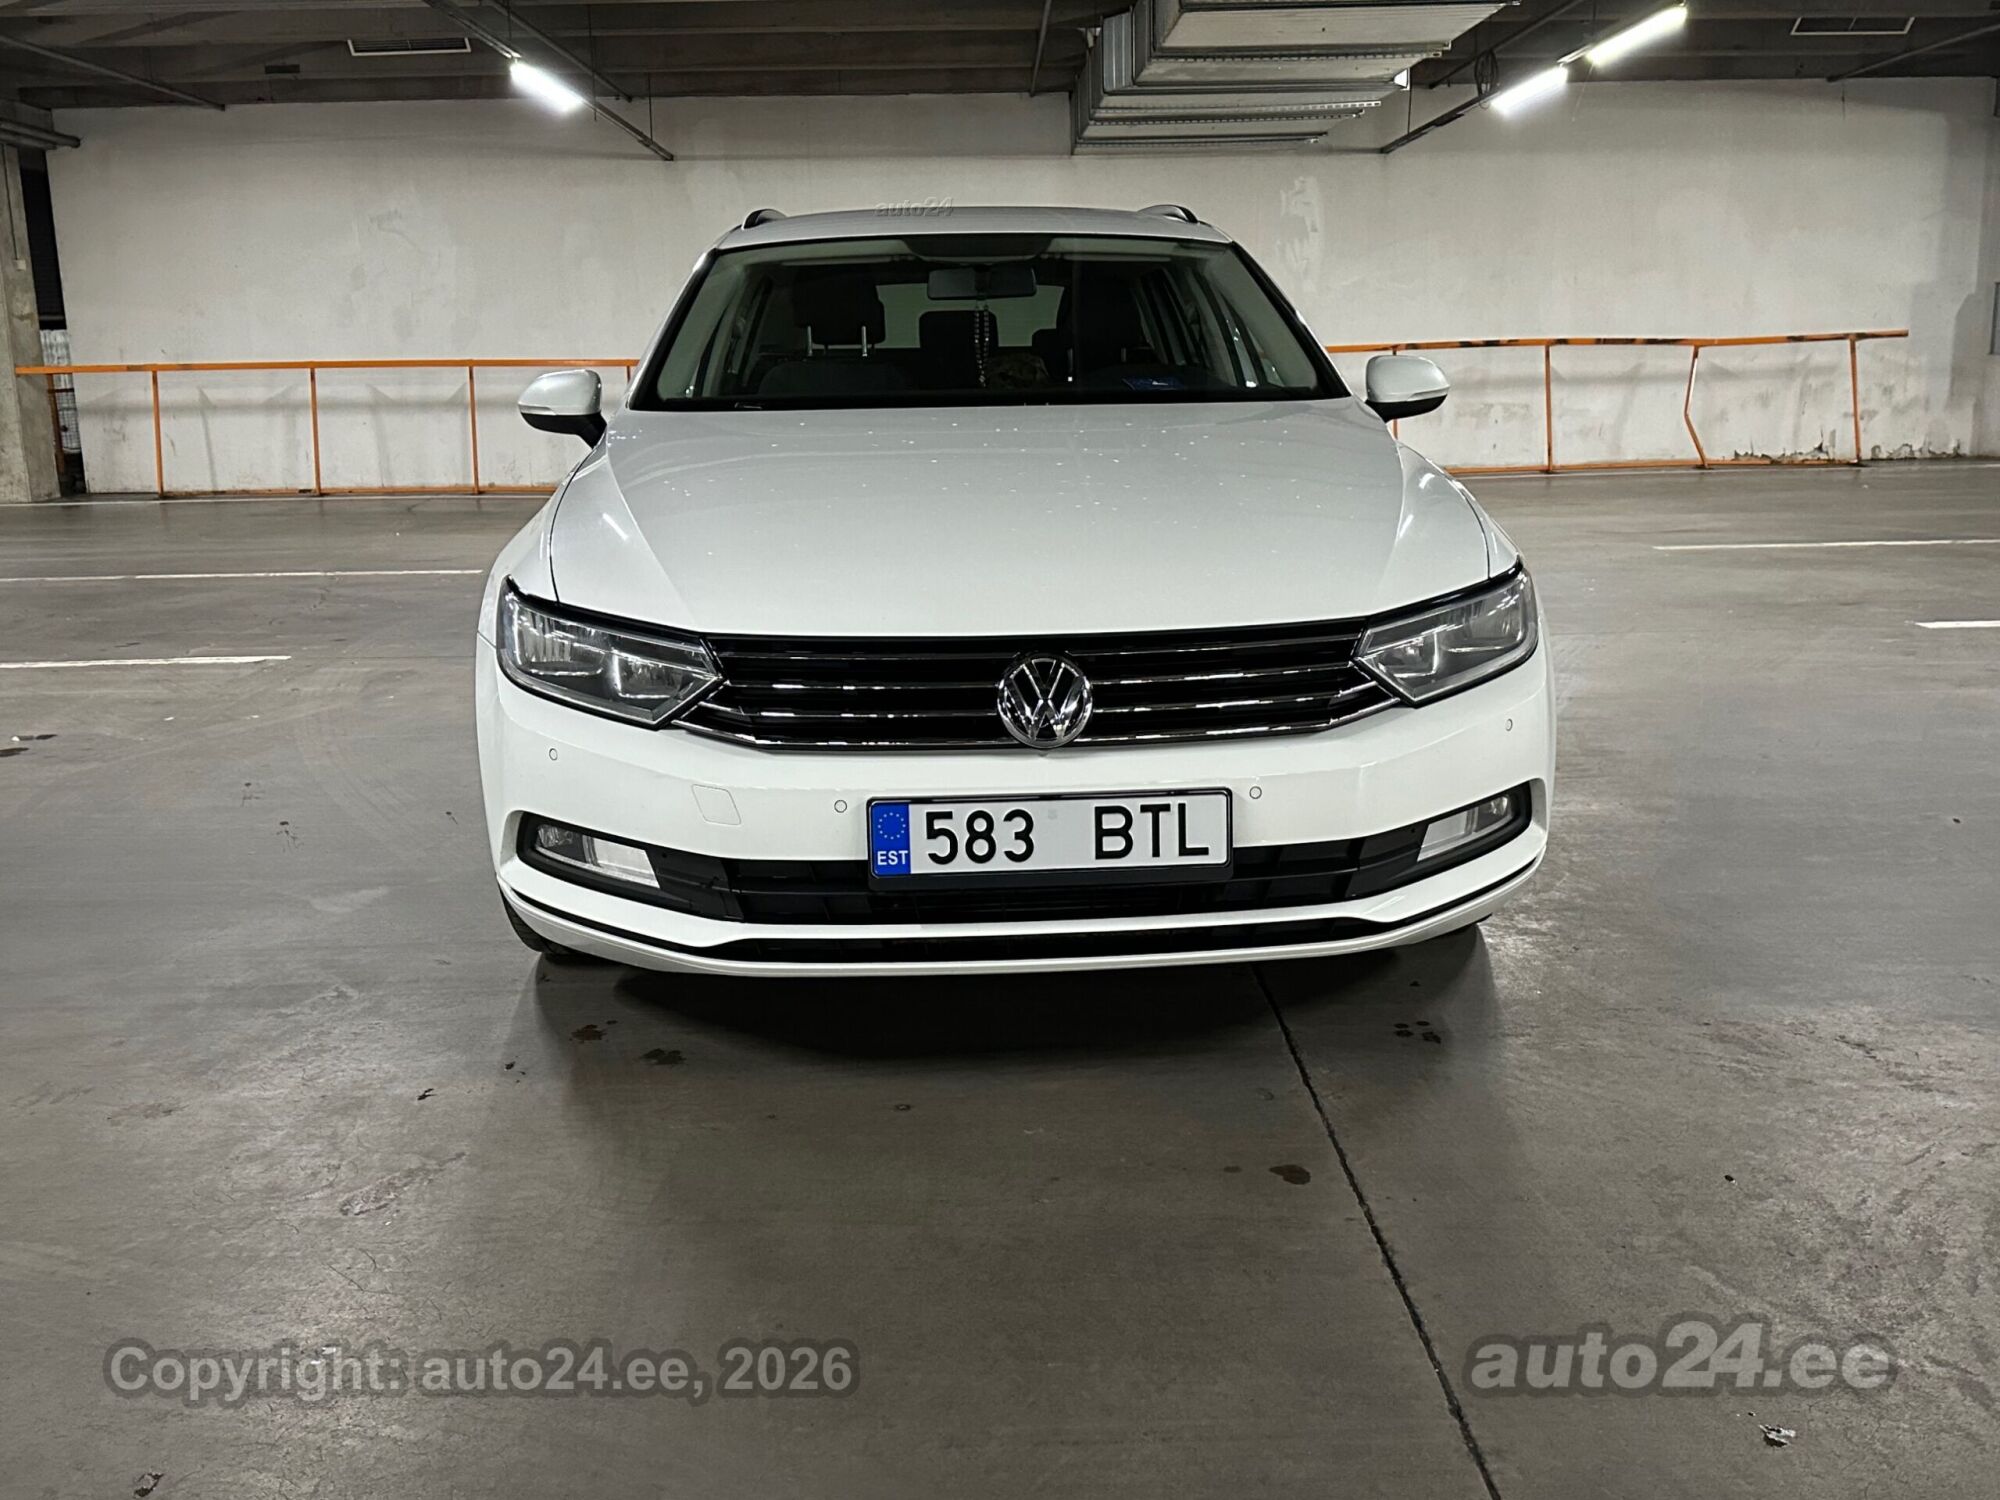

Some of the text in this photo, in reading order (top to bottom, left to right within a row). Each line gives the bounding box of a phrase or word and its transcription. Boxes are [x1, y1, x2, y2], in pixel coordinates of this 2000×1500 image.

[926, 803, 1209, 865] 583 BTL
[877, 851, 908, 866] EST
